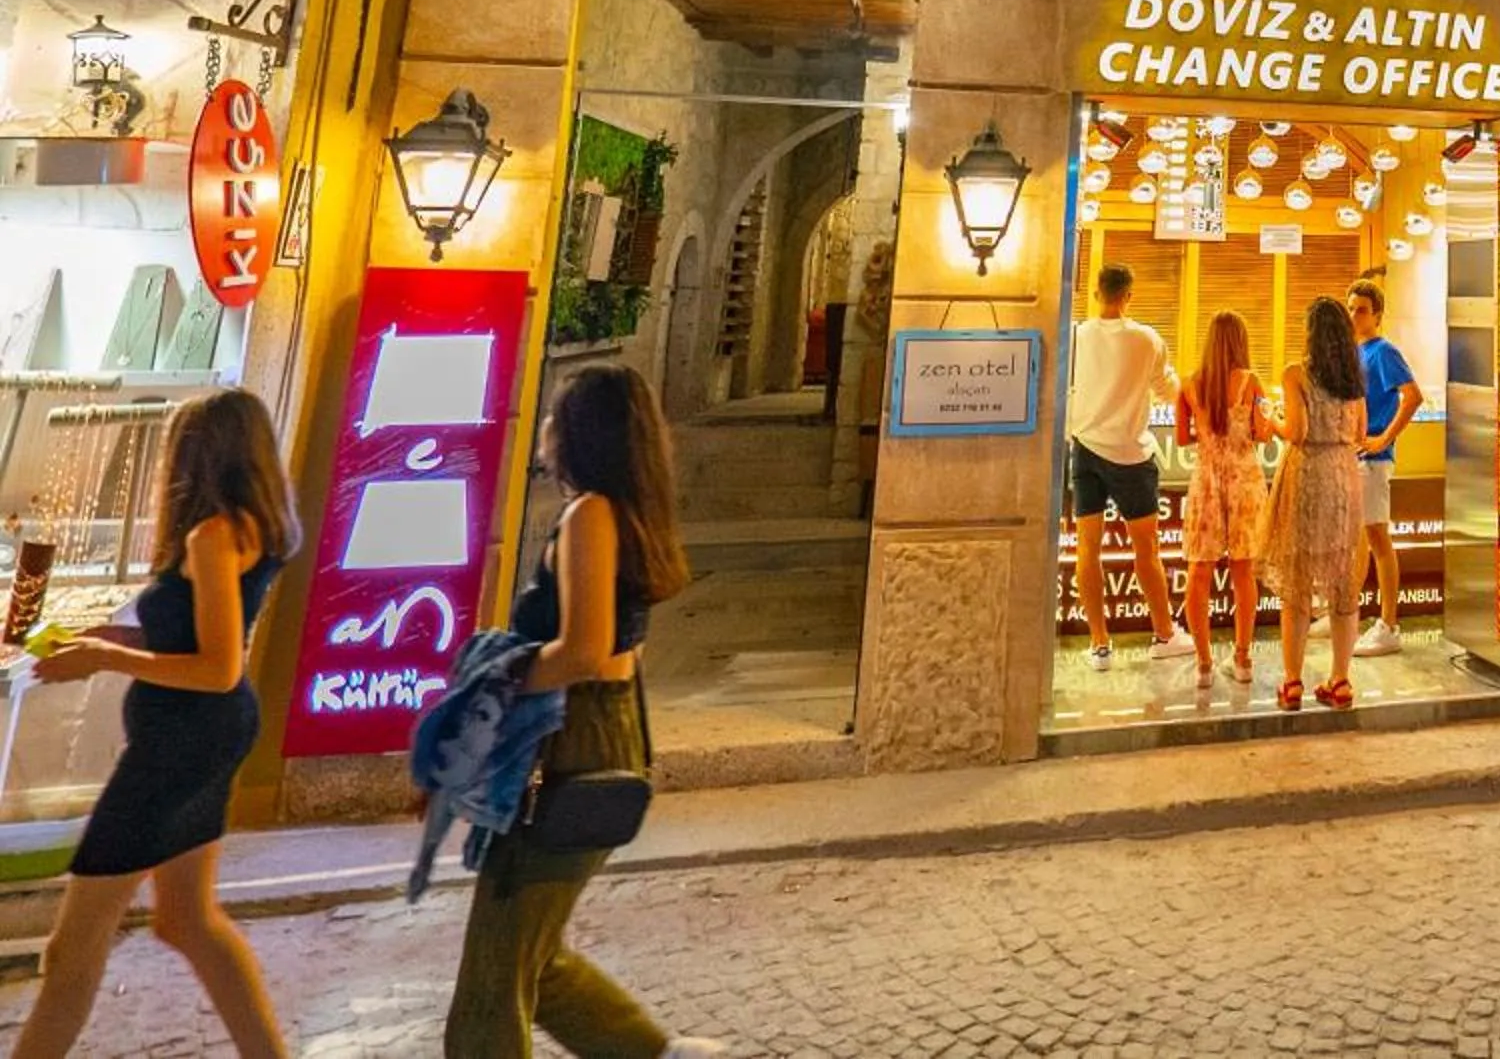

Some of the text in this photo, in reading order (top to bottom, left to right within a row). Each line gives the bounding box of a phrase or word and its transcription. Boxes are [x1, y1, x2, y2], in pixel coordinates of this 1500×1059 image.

[1303, 11, 1334, 42] &
[1344, 6, 1486, 50] ALTIN
[1099, 42, 1326, 91] CHANGE
[918, 354, 1016, 377] zen otel
[311, 668, 447, 712] Kültür
